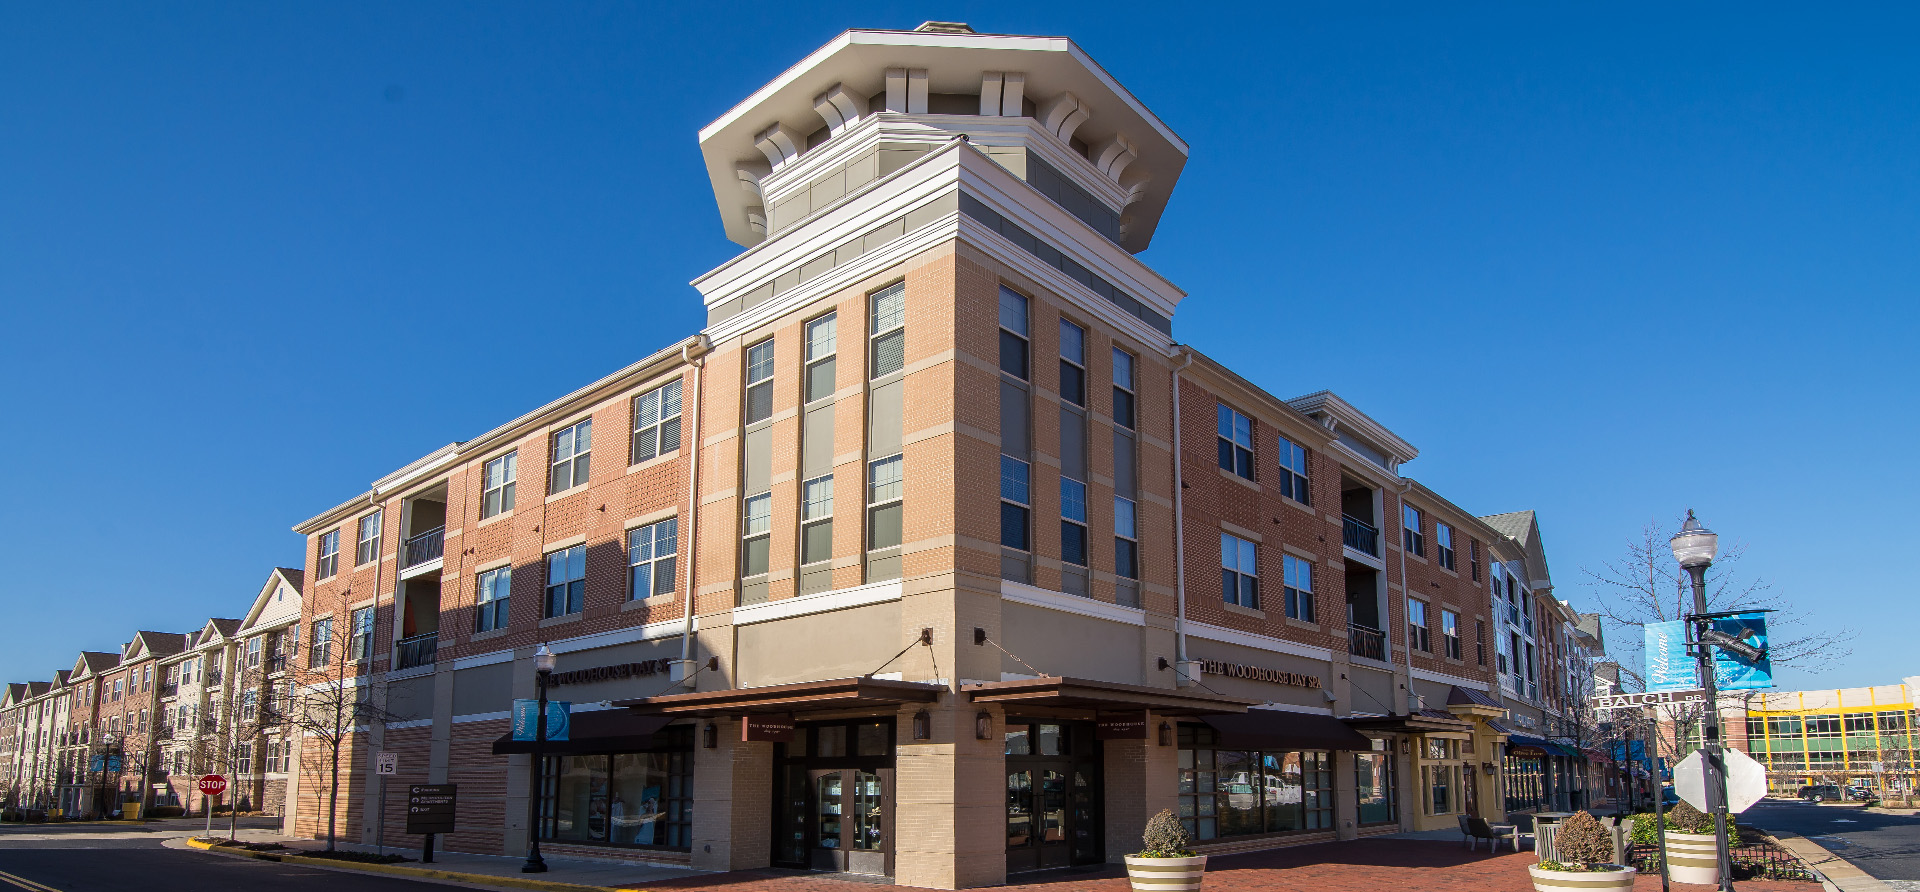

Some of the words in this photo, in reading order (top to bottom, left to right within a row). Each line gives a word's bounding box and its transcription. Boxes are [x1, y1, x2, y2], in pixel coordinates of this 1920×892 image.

[1651, 632, 1669, 684] Welcome
[560, 663, 630, 685] WOODHOUSE
[630, 659, 657, 676] DAY
[1202, 658, 1224, 675] THE
[1226, 662, 1289, 685] WOODHOUSE
[1290, 673, 1307, 687] DAY
[1308, 675, 1323, 689] SPA
[1599, 692, 1674, 708] BALCH
[379, 763, 393, 773] 15
[200, 780, 225, 788] STOP
